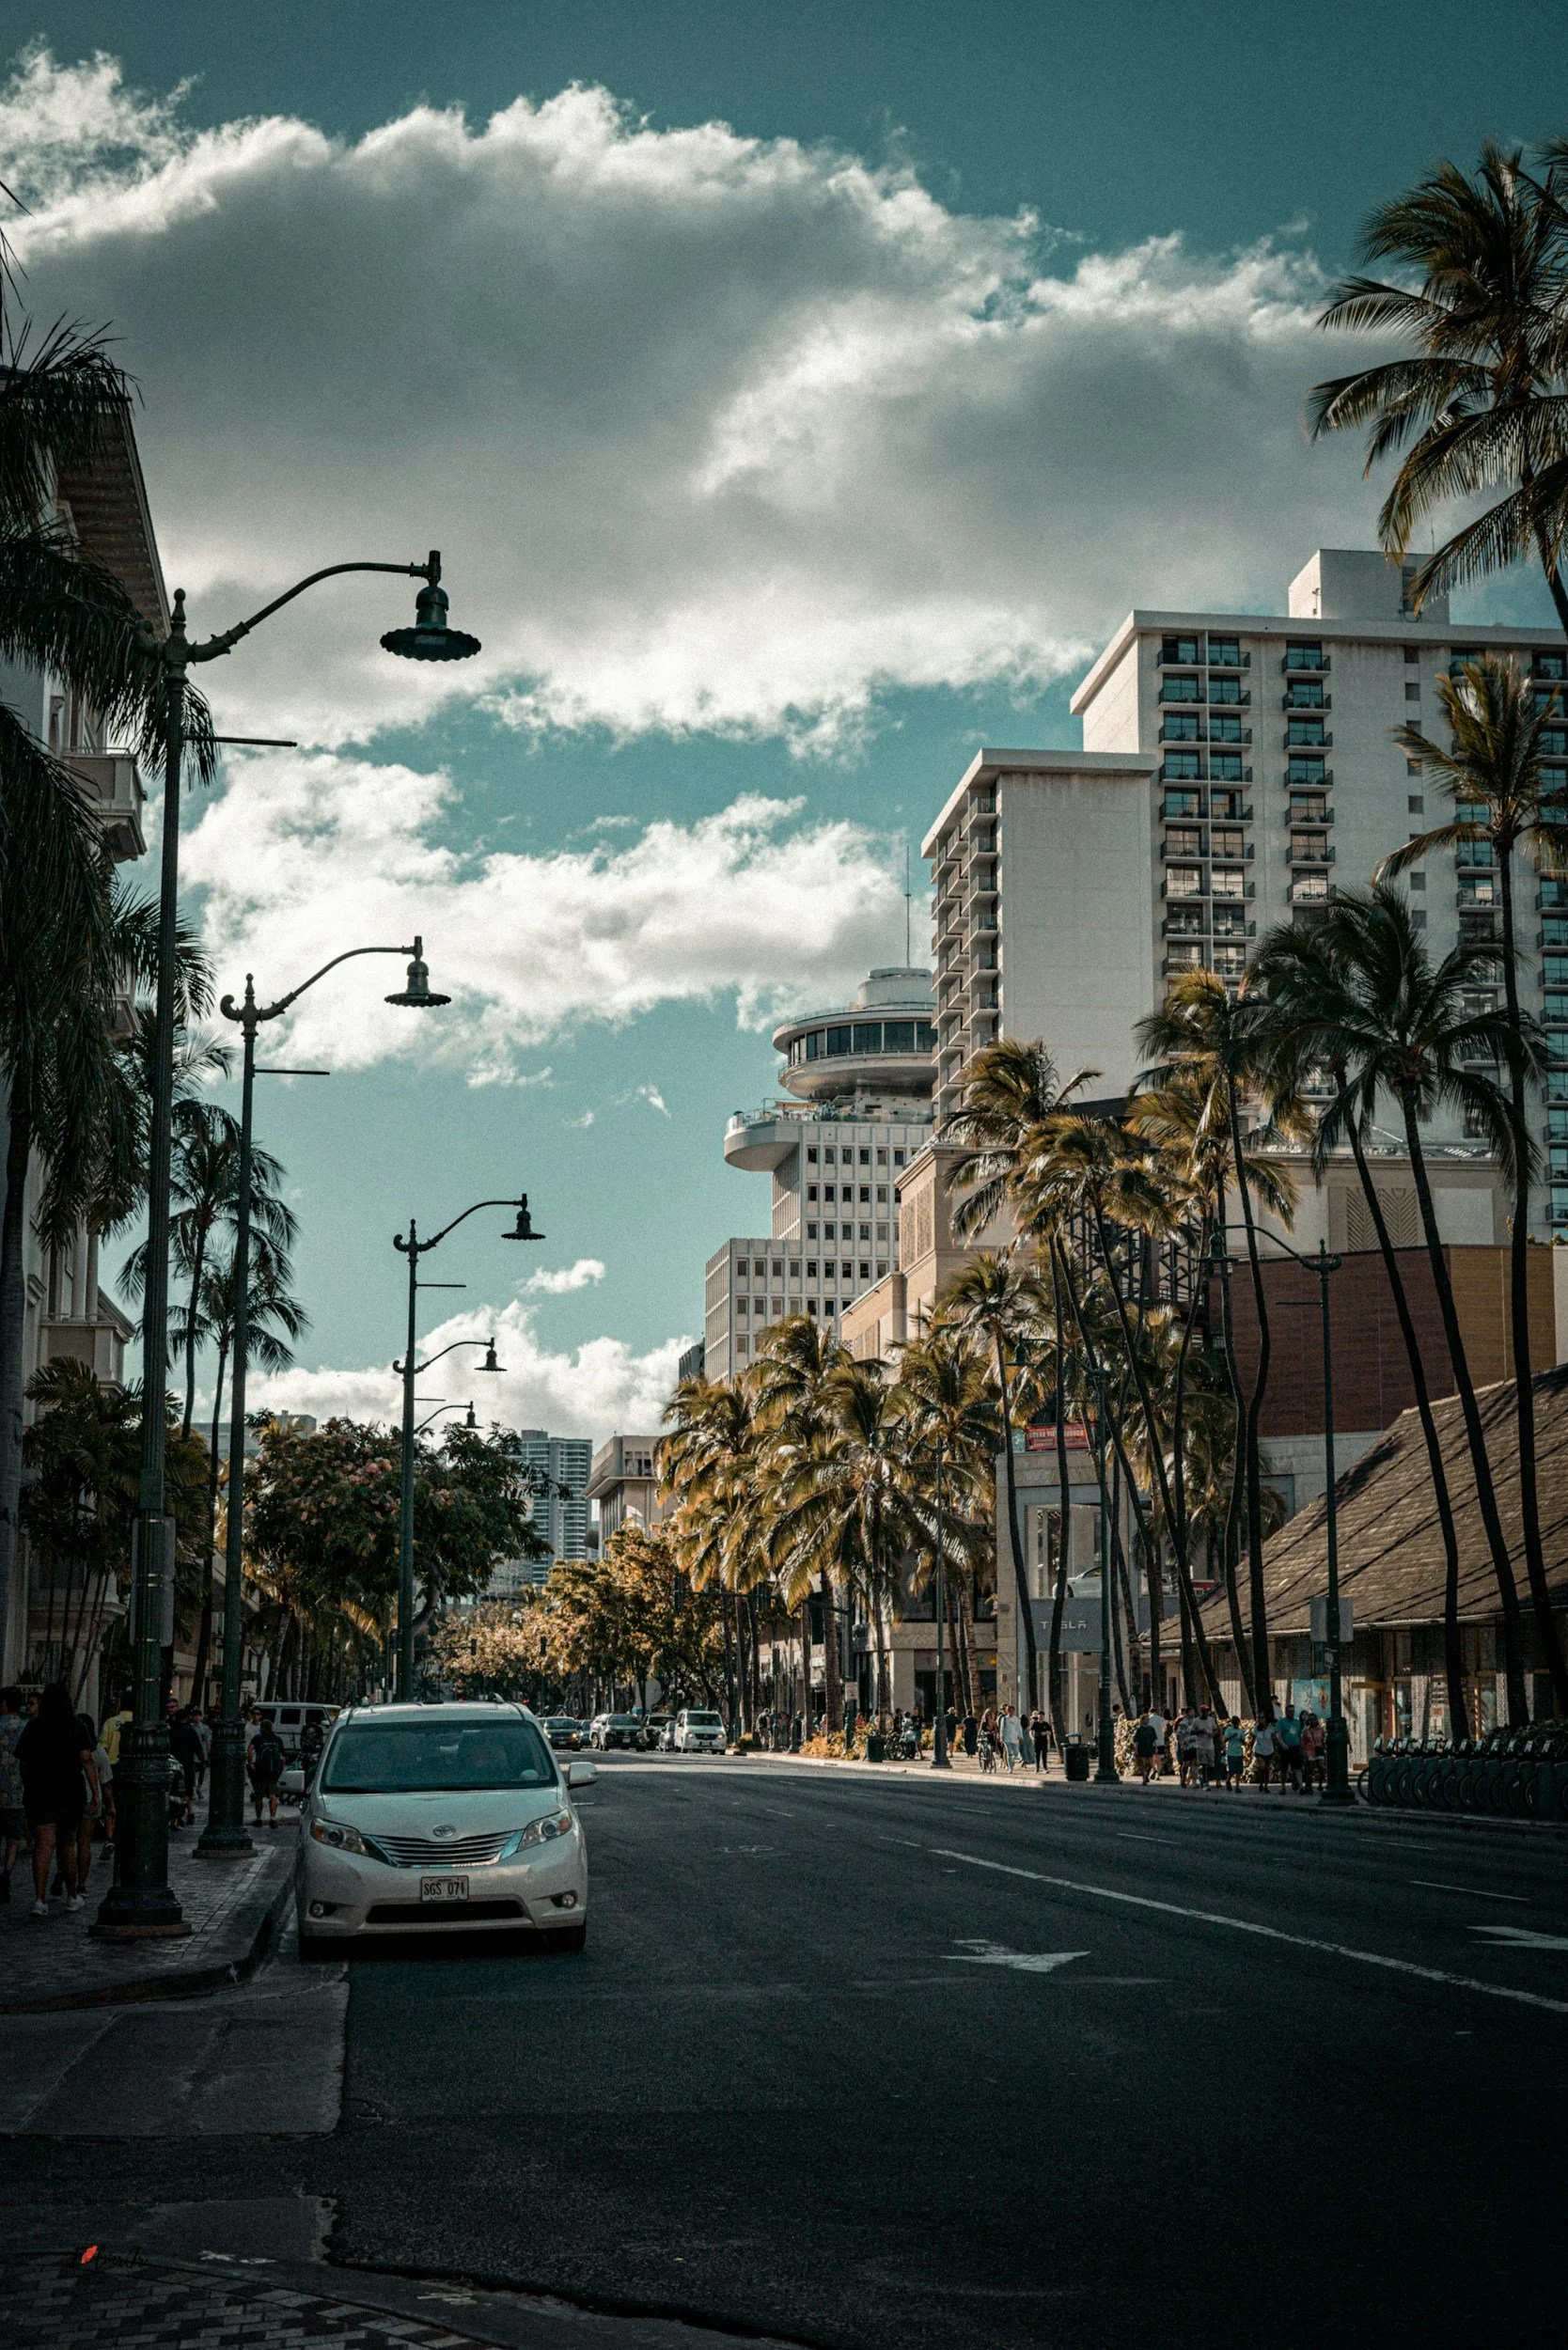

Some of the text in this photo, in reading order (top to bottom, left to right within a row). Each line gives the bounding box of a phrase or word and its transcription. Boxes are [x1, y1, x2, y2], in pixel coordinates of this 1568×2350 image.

[1041, 1621, 1087, 1629] TSLA
[424, 1882, 464, 1895] SGS 071
